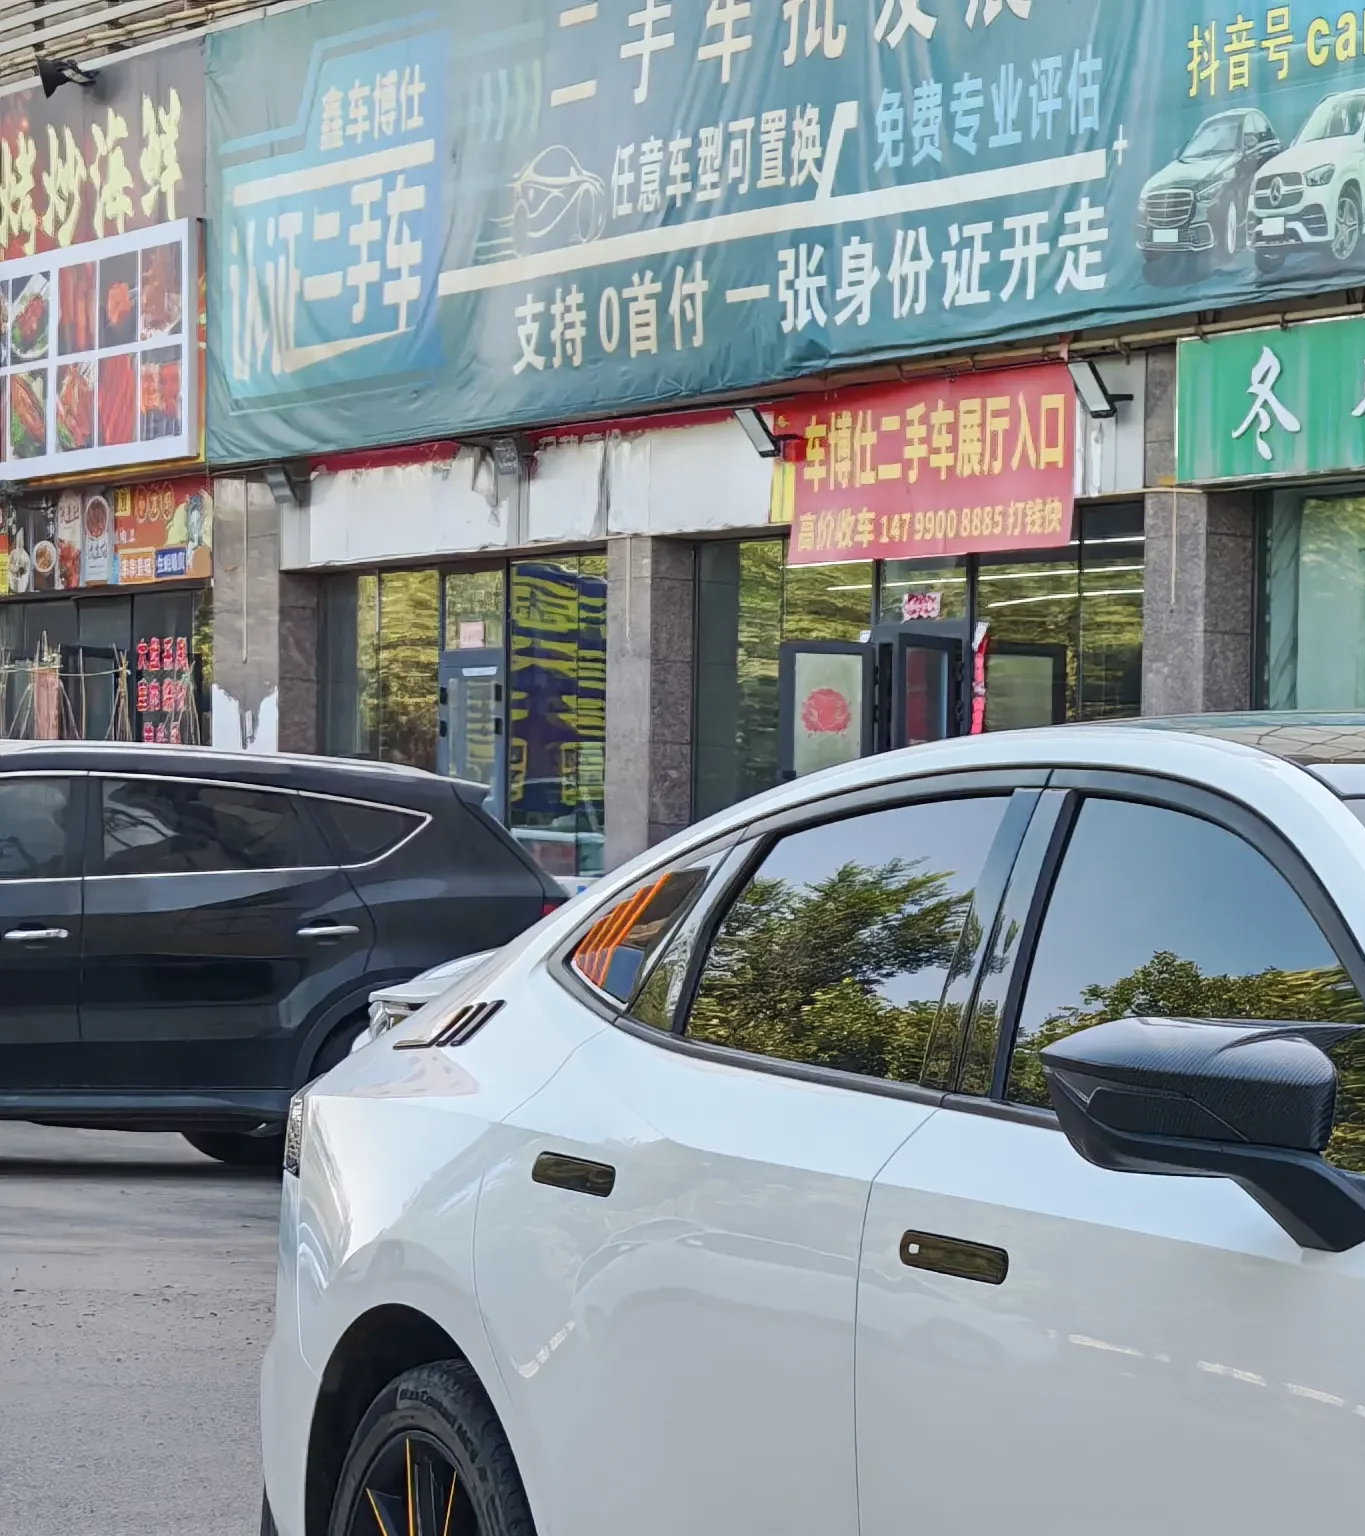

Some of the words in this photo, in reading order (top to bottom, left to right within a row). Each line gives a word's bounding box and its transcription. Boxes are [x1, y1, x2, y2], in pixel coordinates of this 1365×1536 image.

[611, 104, 826, 220] 任意车型可置换
[873, 47, 1104, 170] 免费专业评估
[229, 174, 426, 381] 认证二手车
